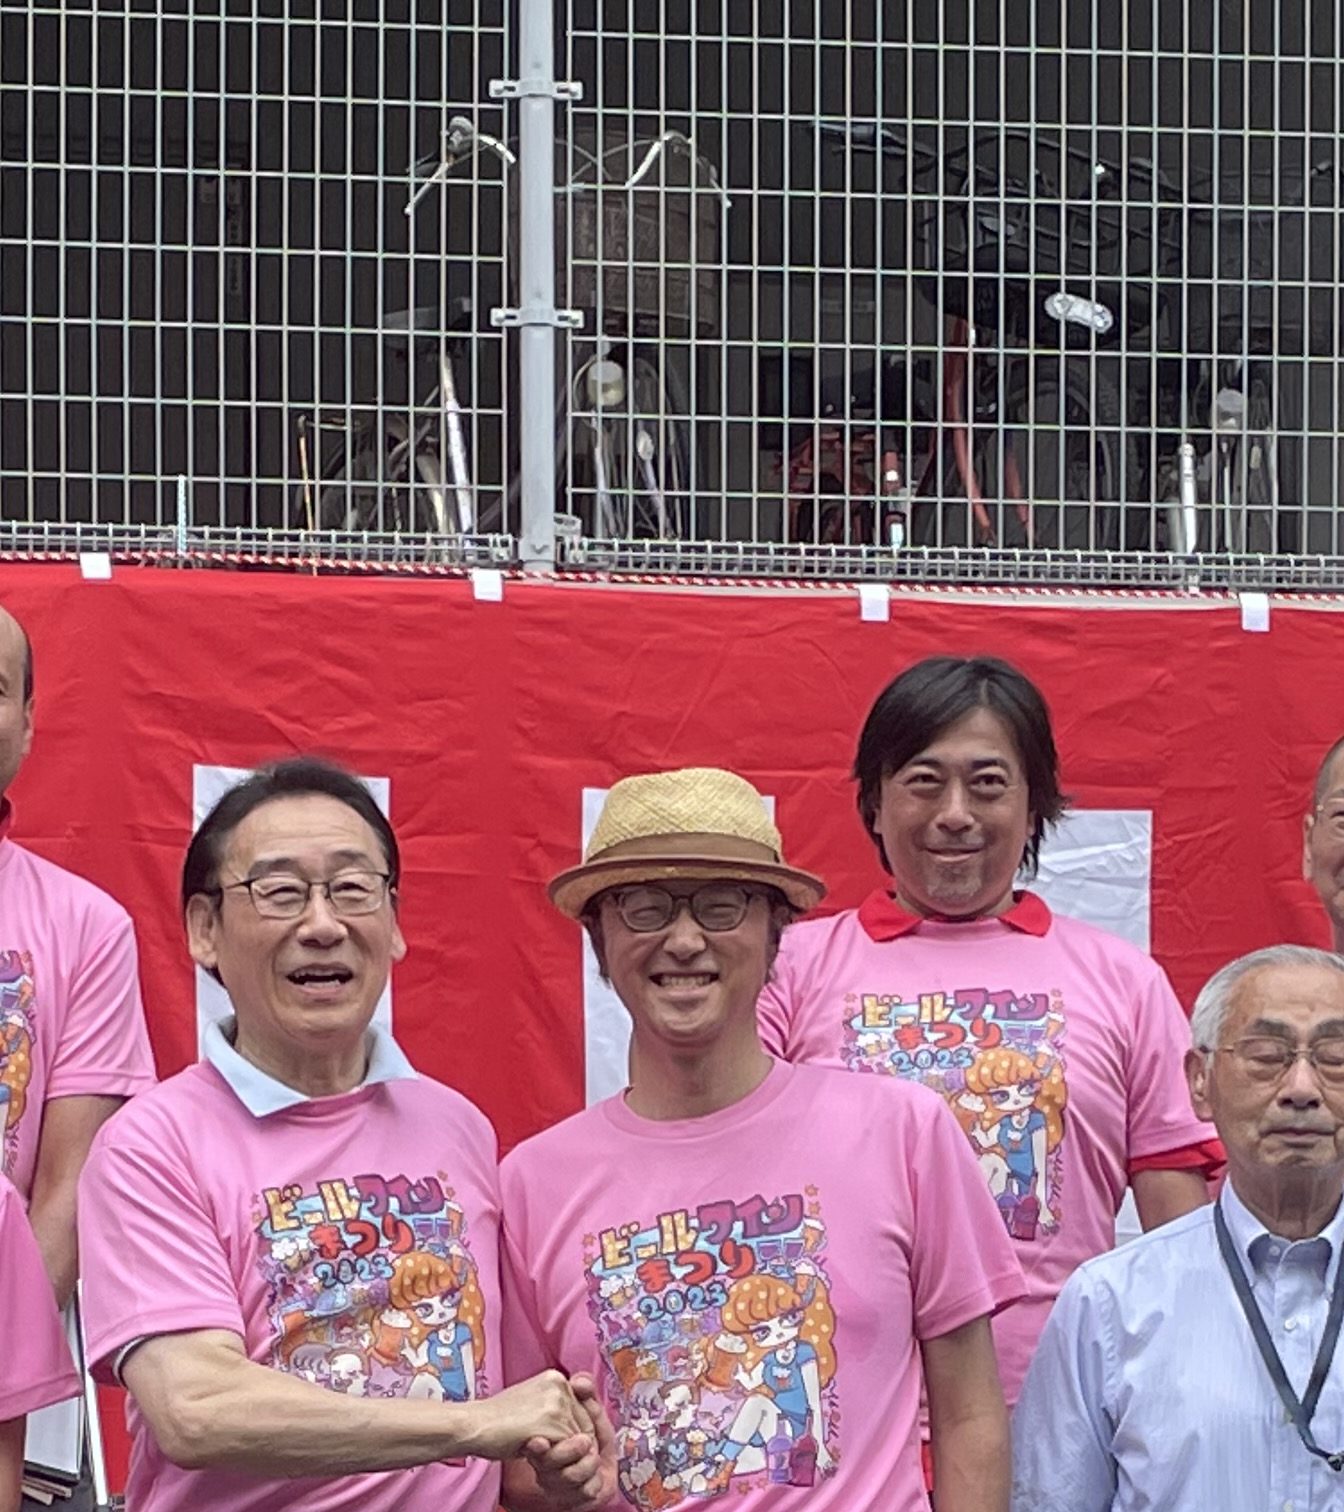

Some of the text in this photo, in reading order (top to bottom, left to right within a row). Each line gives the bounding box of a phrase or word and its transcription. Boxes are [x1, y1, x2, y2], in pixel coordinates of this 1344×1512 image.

[860, 988, 1050, 1029] ビールワイン
[893, 1017, 1002, 1050] まつり
[890, 1049, 973, 1072] 2023
[262, 1174, 446, 1232] ビールワイン
[308, 1211, 415, 1259] まつり
[599, 1194, 804, 1271] ビールワイン
[313, 1254, 394, 1288] 2023
[636, 1238, 755, 1293] まつり
[637, 1282, 727, 1320] 2023
